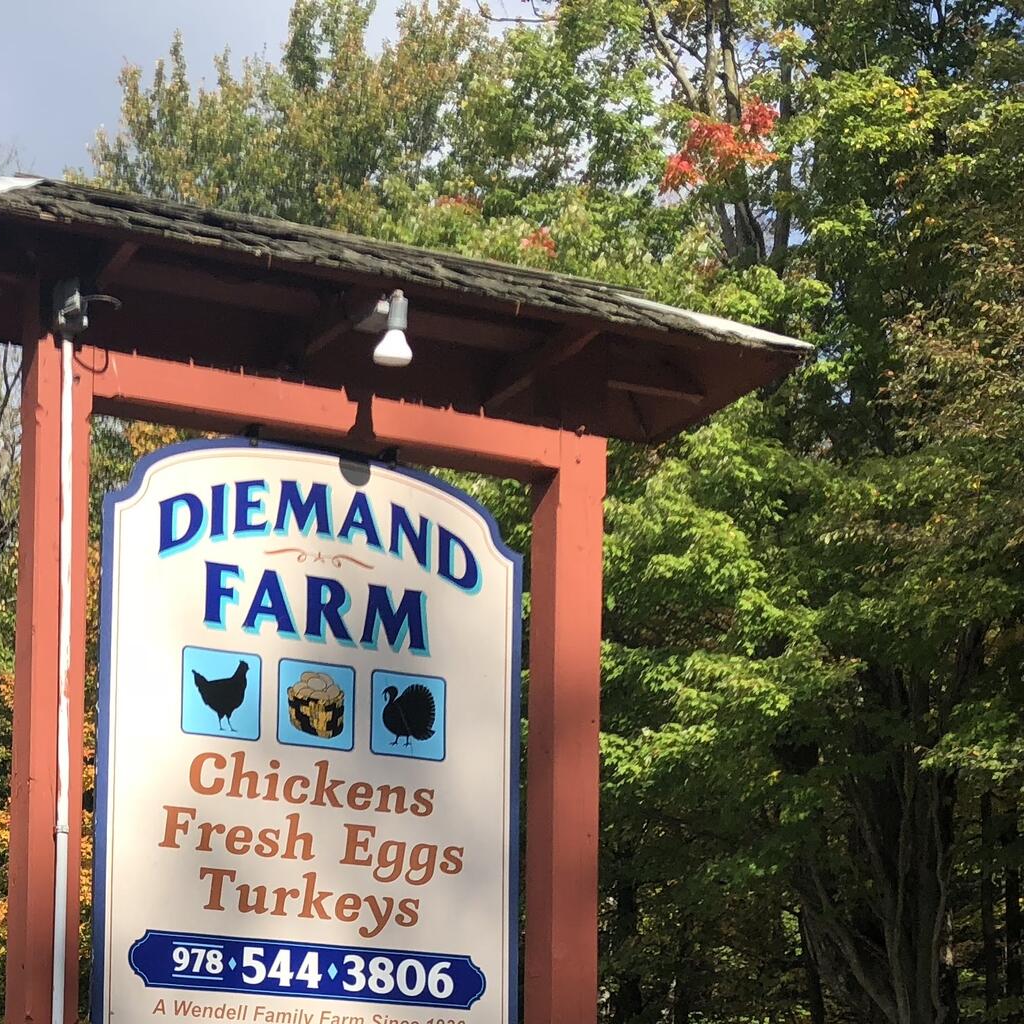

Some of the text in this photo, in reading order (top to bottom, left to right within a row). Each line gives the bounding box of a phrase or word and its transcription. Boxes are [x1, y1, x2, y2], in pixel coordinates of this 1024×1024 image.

[158, 479, 483, 596] DIEMAND
[202, 561, 431, 658] FARM
[189, 750, 436, 817] Chickens
[158, 805, 465, 886] Fresh Eggs
[199, 867, 421, 939] Turkeys
[152, 999, 167, 1016] A
[174, 1001, 249, 1022] Wendell
